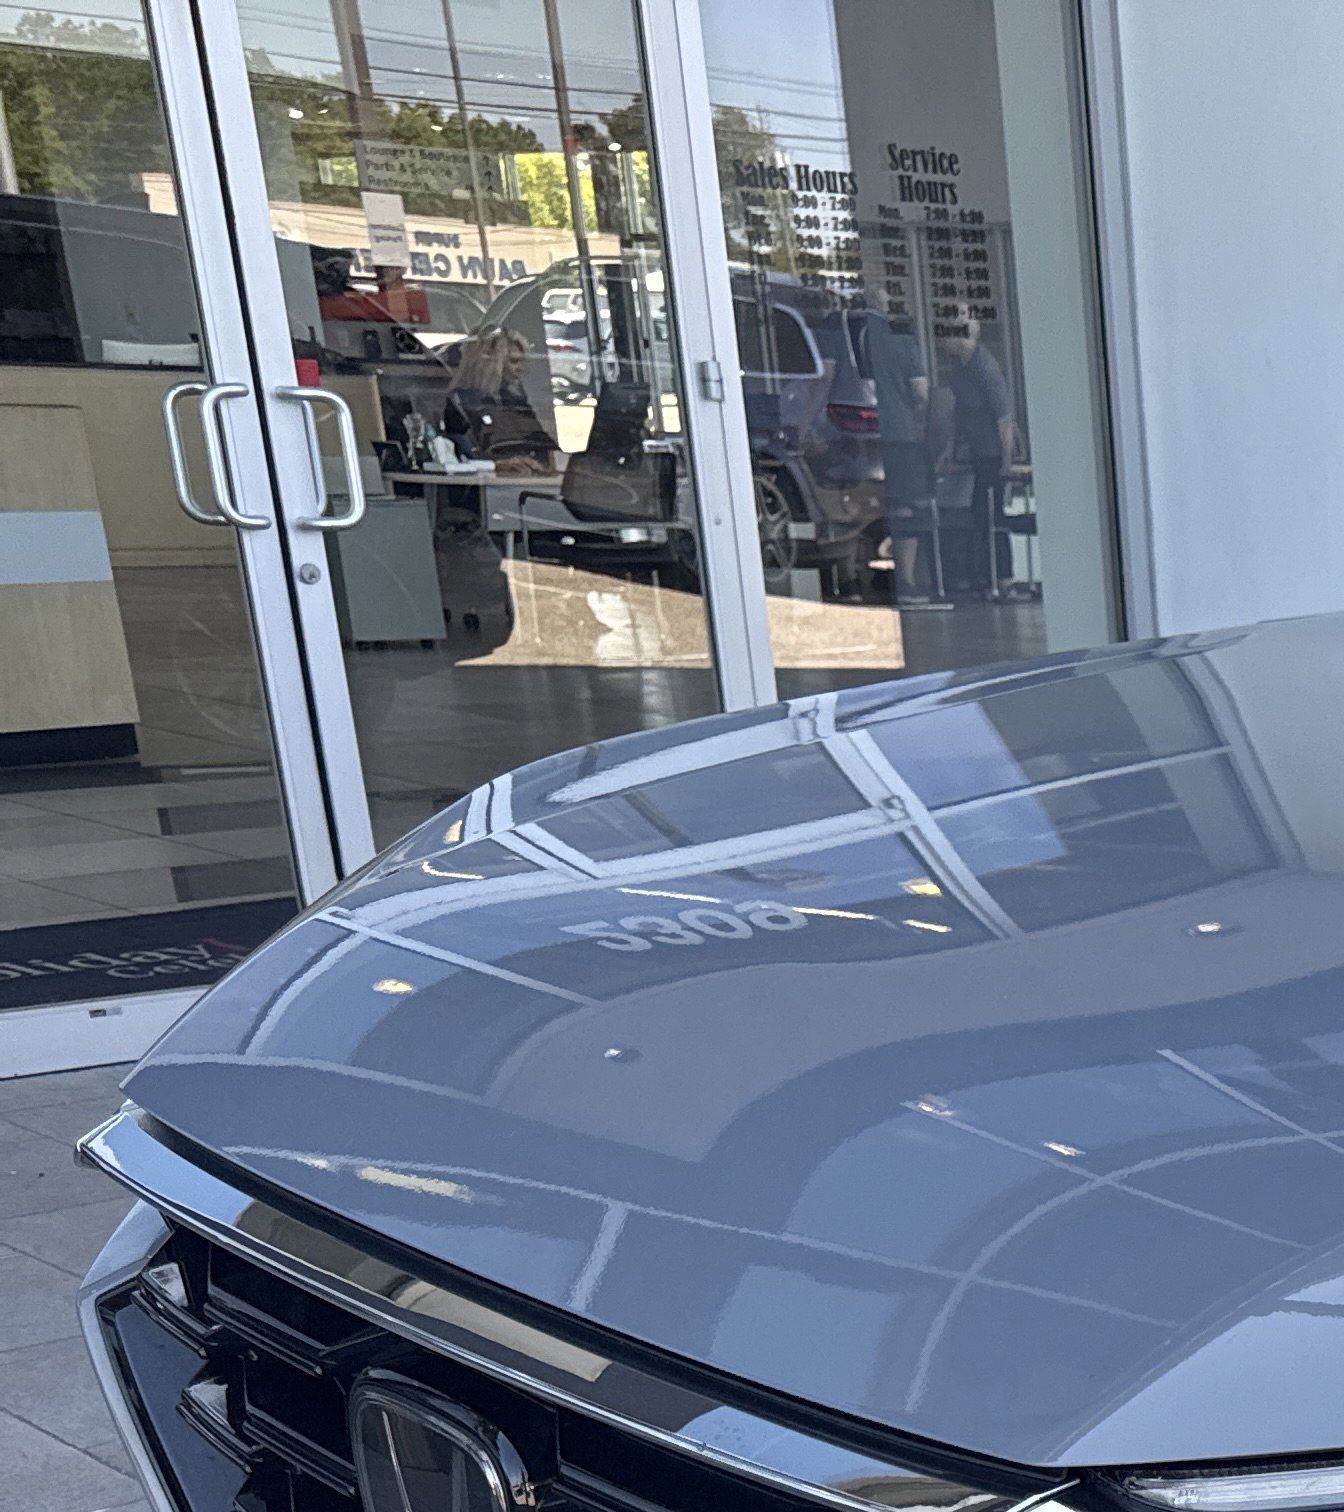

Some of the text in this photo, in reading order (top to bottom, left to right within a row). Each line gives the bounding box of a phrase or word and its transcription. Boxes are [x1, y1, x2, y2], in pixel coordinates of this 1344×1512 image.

[887, 143, 960, 176] Service
[733, 160, 859, 195] Sales Hours
[898, 174, 958, 205] Hours
[829, 196, 856, 211] 7:00
